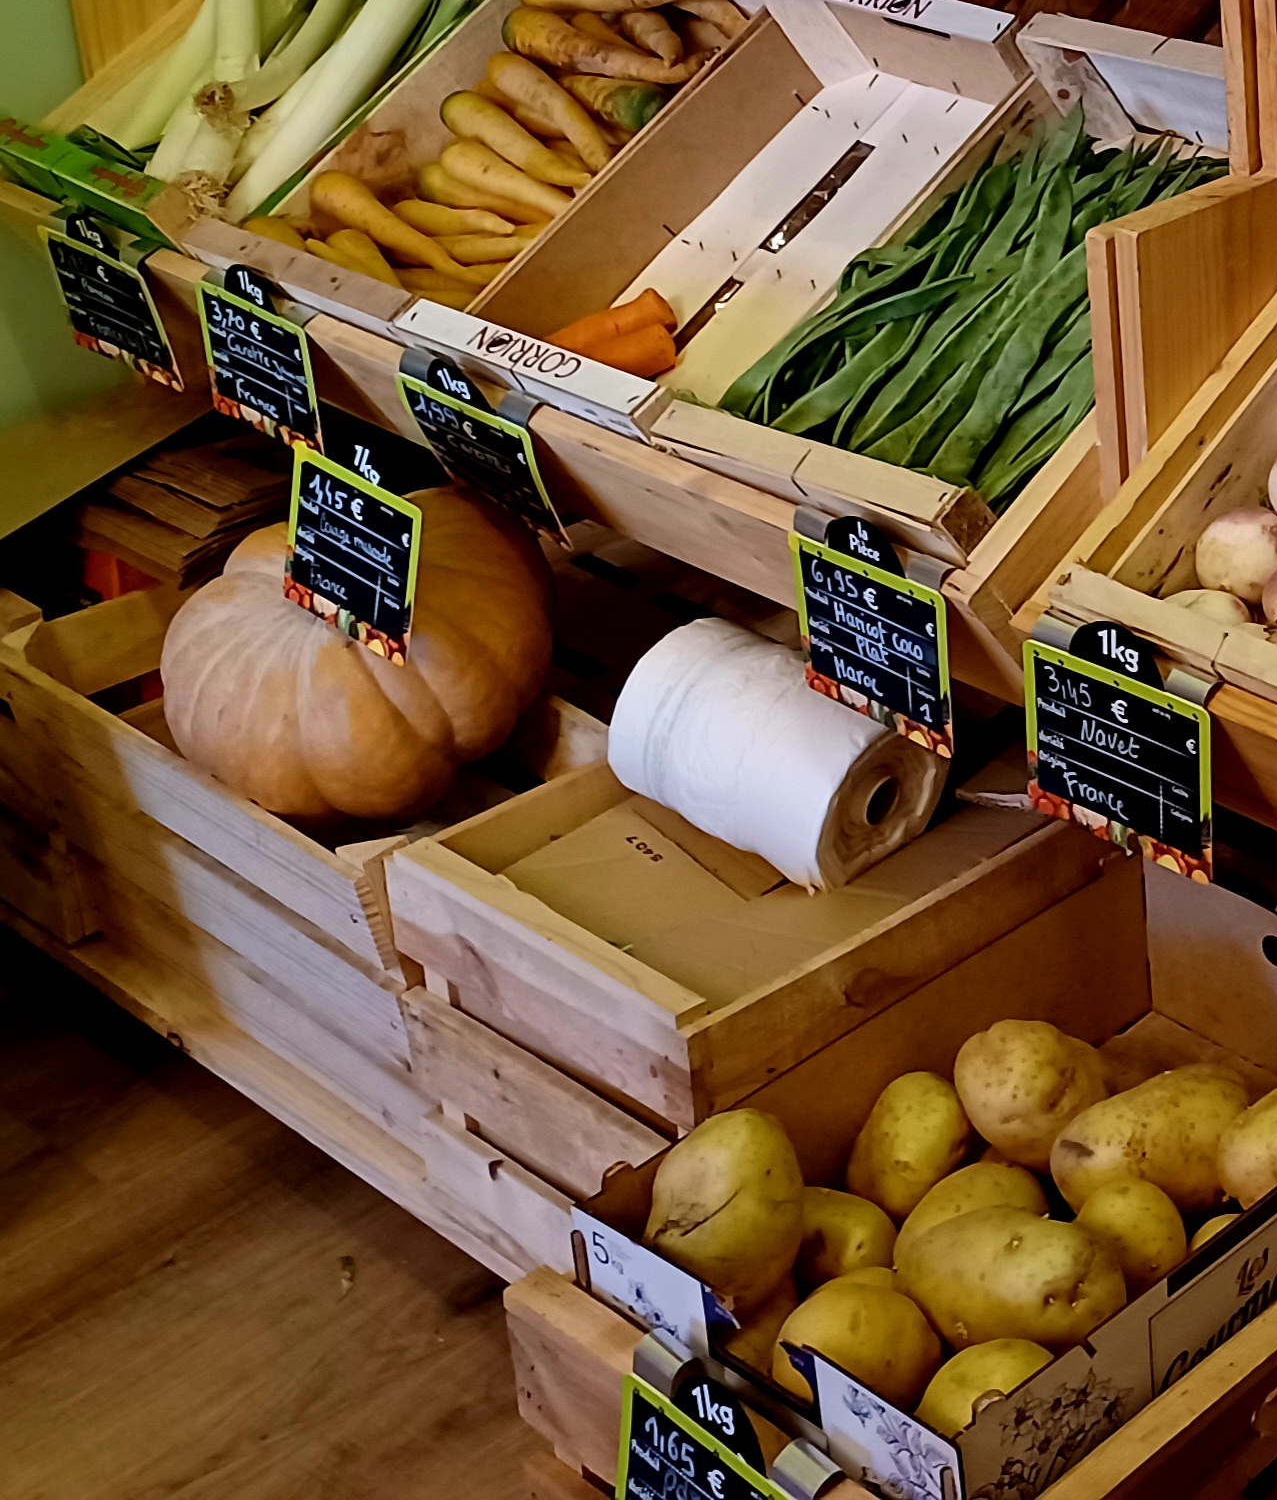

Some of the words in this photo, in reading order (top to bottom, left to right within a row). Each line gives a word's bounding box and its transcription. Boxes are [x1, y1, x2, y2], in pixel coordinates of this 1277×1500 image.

[236, 270, 264, 305] 1kg
[437, 368, 471, 400] 1kg
[1097, 629, 1139, 673] 1kg
[1044, 665, 1091, 708] 3,45
[1111, 700, 1129, 723] €
[1081, 719, 1141, 758] Navet
[1063, 772, 1129, 821] France
[592, 1231, 609, 1264] 5
[691, 1384, 735, 1436] 1kg
[645, 1417, 695, 1478] 1,65
